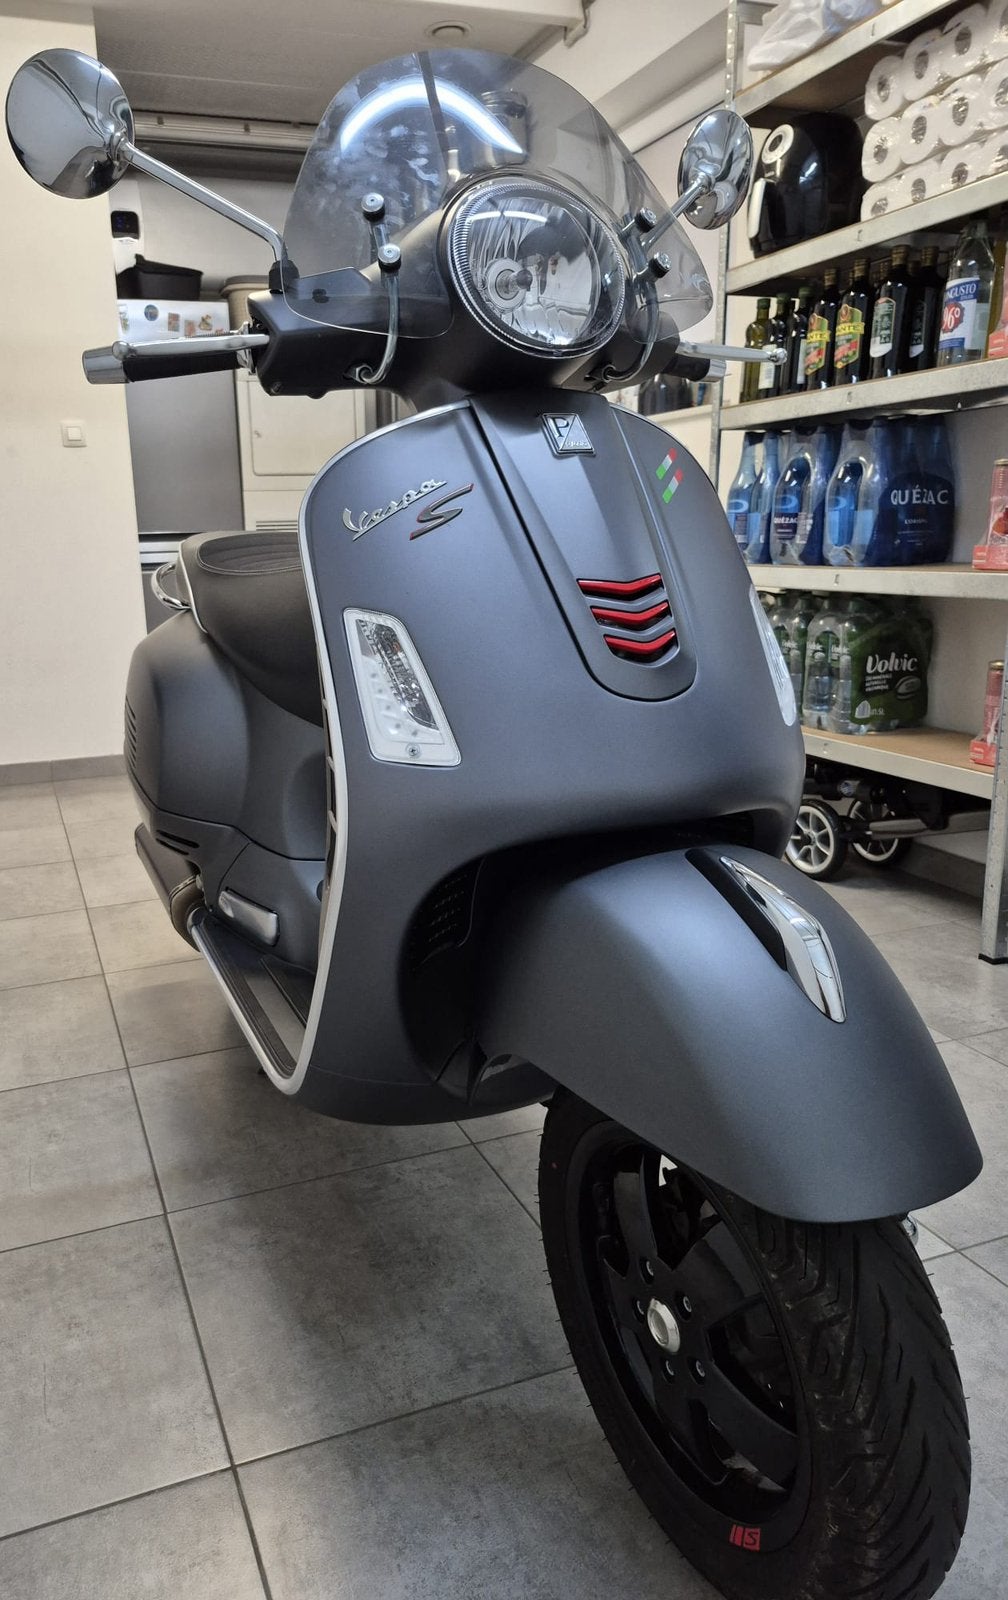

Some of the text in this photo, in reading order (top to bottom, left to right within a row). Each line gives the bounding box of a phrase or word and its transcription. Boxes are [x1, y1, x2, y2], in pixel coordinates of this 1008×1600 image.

[549, 416, 570, 438] P
[890, 484, 949, 505] QUÉZAC
[342, 478, 474, 542] Vespa S
[865, 651, 918, 674] Volvic
